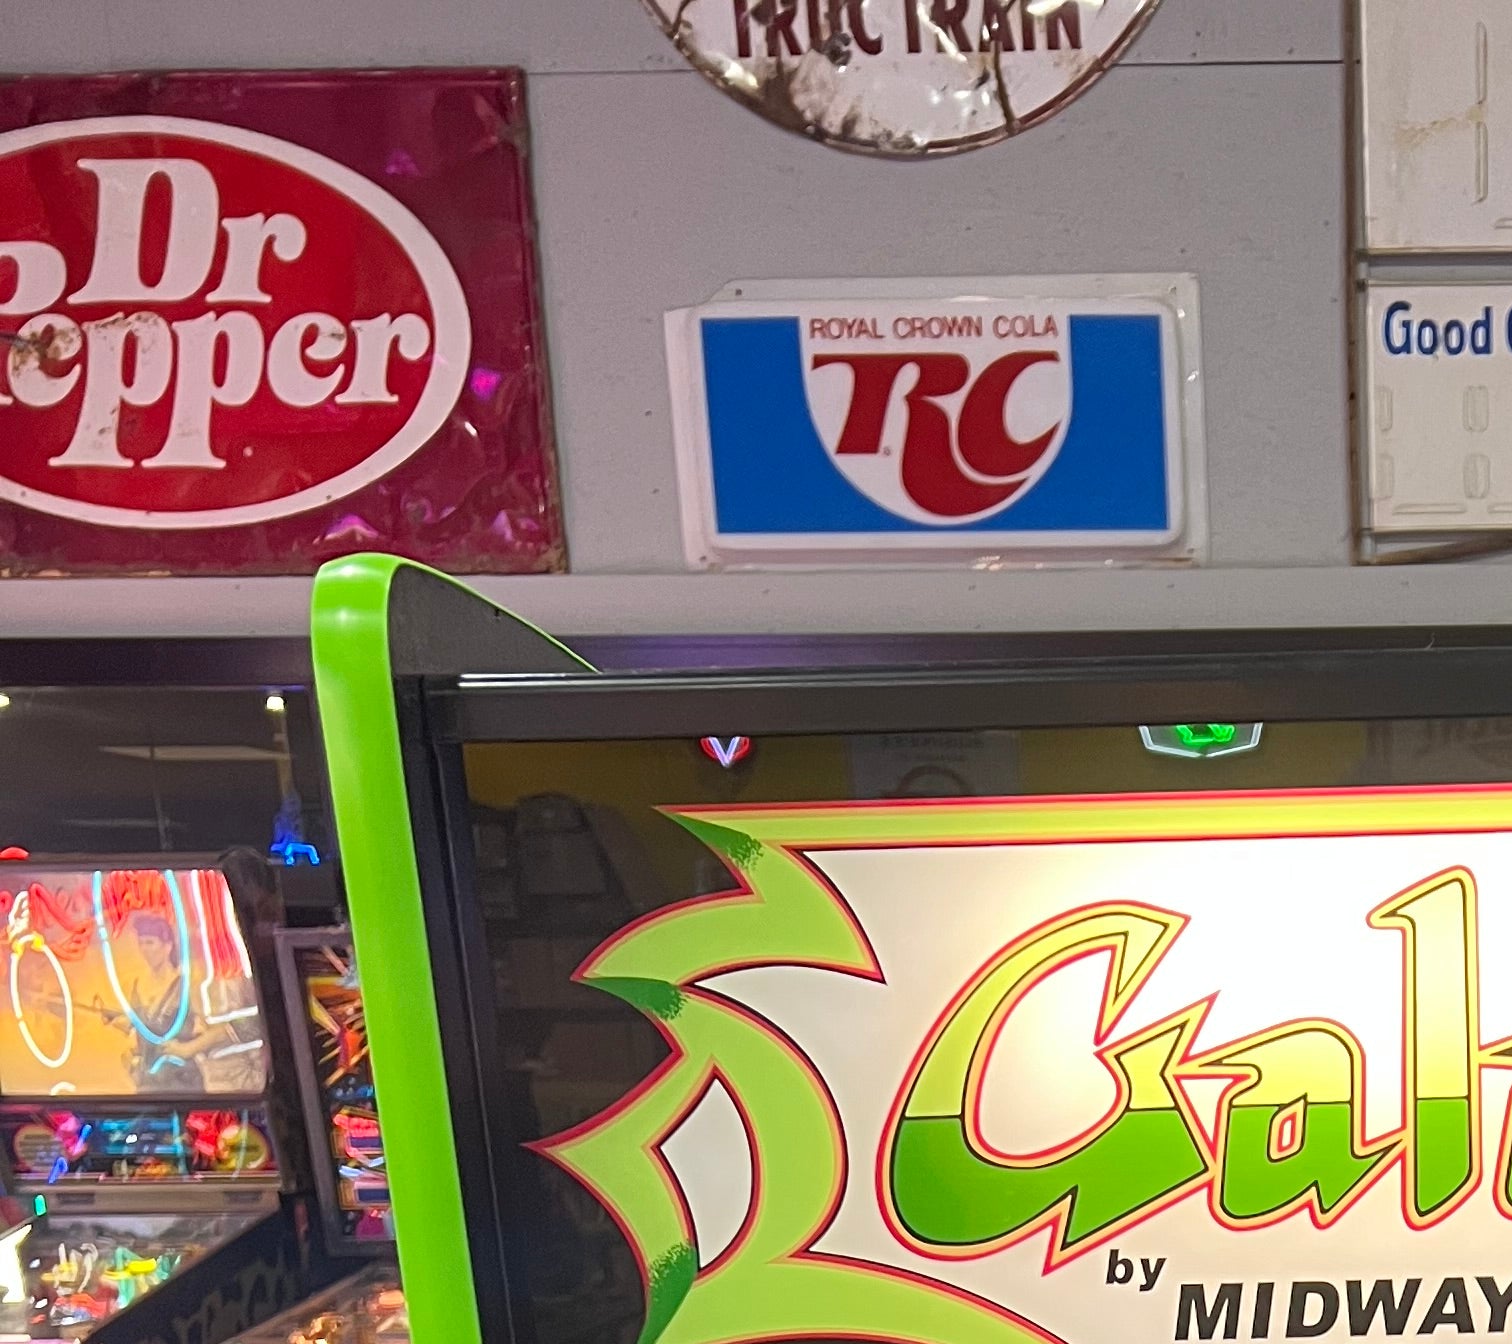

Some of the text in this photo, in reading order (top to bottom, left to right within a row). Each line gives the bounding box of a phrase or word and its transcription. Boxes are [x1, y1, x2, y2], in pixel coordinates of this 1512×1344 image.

[66, 158, 307, 303] Dr
[809, 314, 1059, 339] ROYAL CROWN COLA
[1384, 300, 1493, 355] Good
[811, 350, 1061, 516] RC
[1106, 1249, 1167, 1291] by
